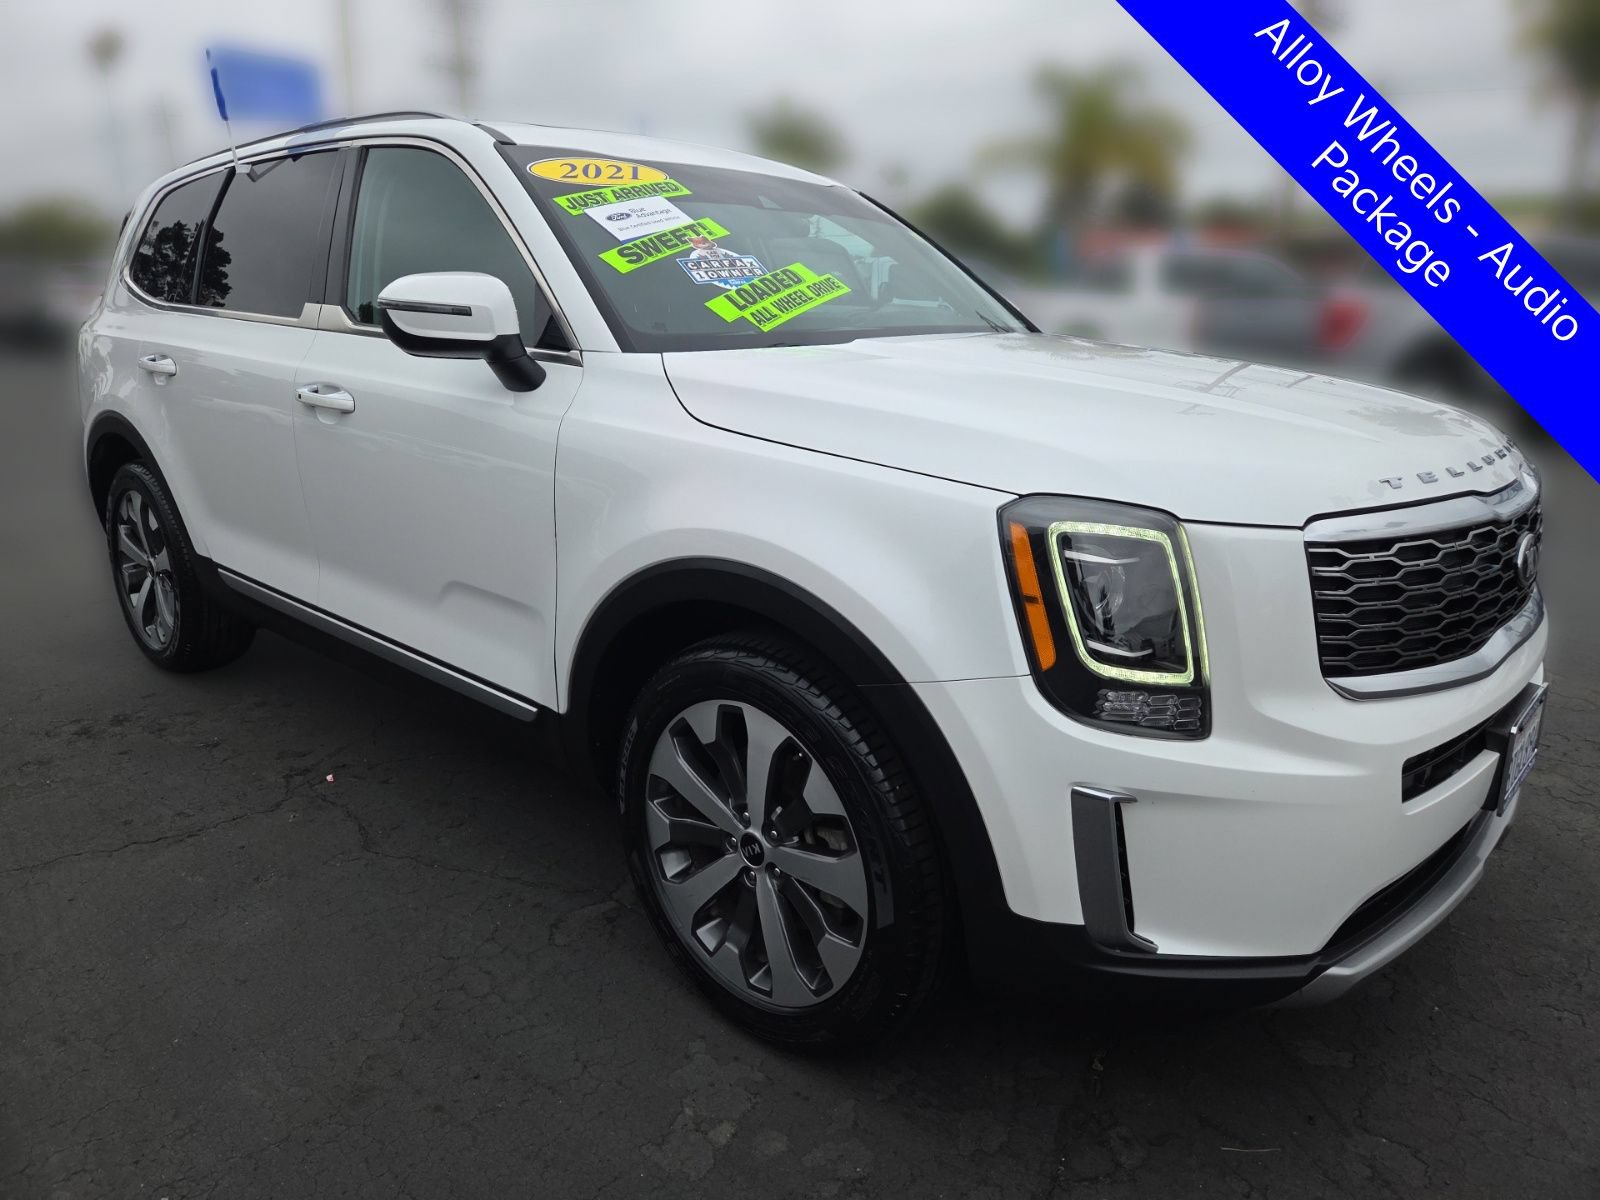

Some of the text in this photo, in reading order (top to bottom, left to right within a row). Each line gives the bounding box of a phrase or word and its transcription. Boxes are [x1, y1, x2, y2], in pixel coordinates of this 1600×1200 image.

[559, 162, 641, 180] 2021
[566, 181, 682, 211] JUST ARRIVED
[617, 222, 714, 265] SWEET!
[687, 259, 756, 270] CARFAX
[707, 268, 764, 279] OWNER
[723, 268, 805, 312] LOADED
[750, 277, 841, 326] ALL WHEEL DRIVE
[741, 843, 761, 857] KIA
